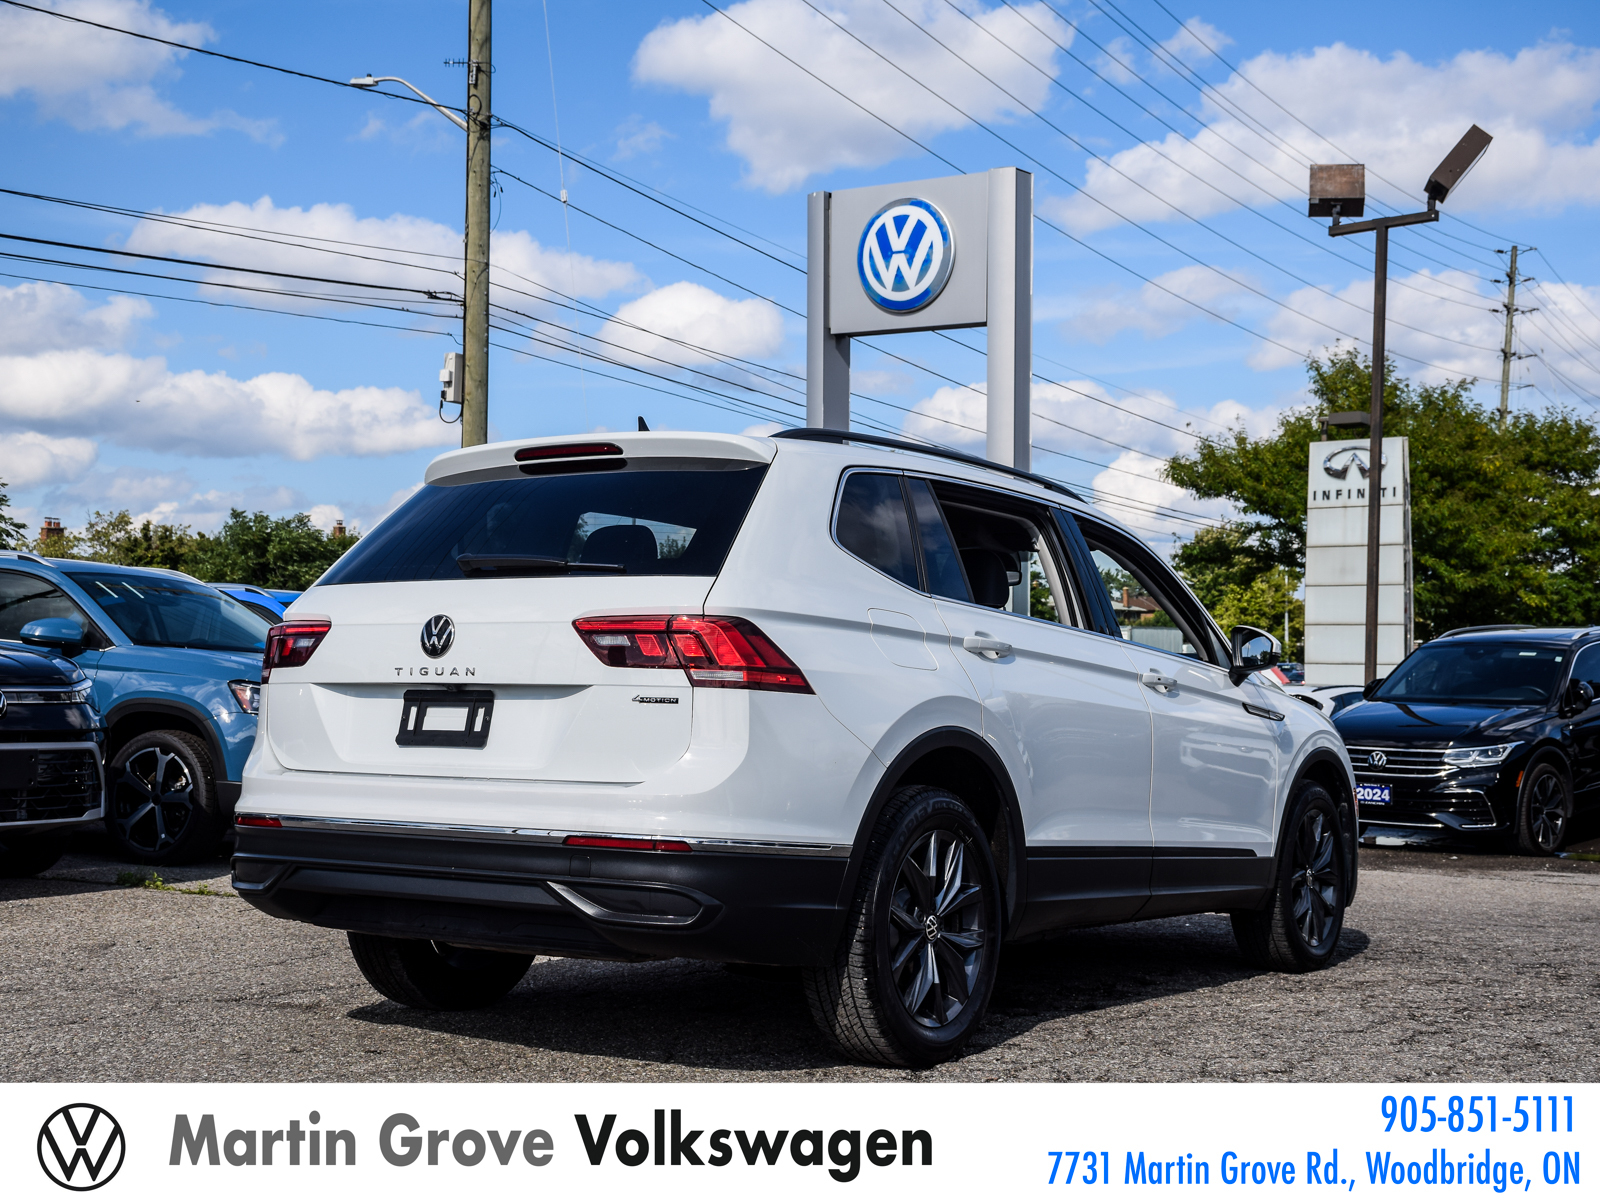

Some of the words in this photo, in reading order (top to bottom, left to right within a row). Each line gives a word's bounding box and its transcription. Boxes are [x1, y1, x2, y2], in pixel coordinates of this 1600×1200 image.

[1313, 486, 1396, 501] INFINTI
[394, 666, 476, 677] TIGUAN
[632, 694, 679, 704] 4MOTION
[1356, 787, 1390, 801] 2024
